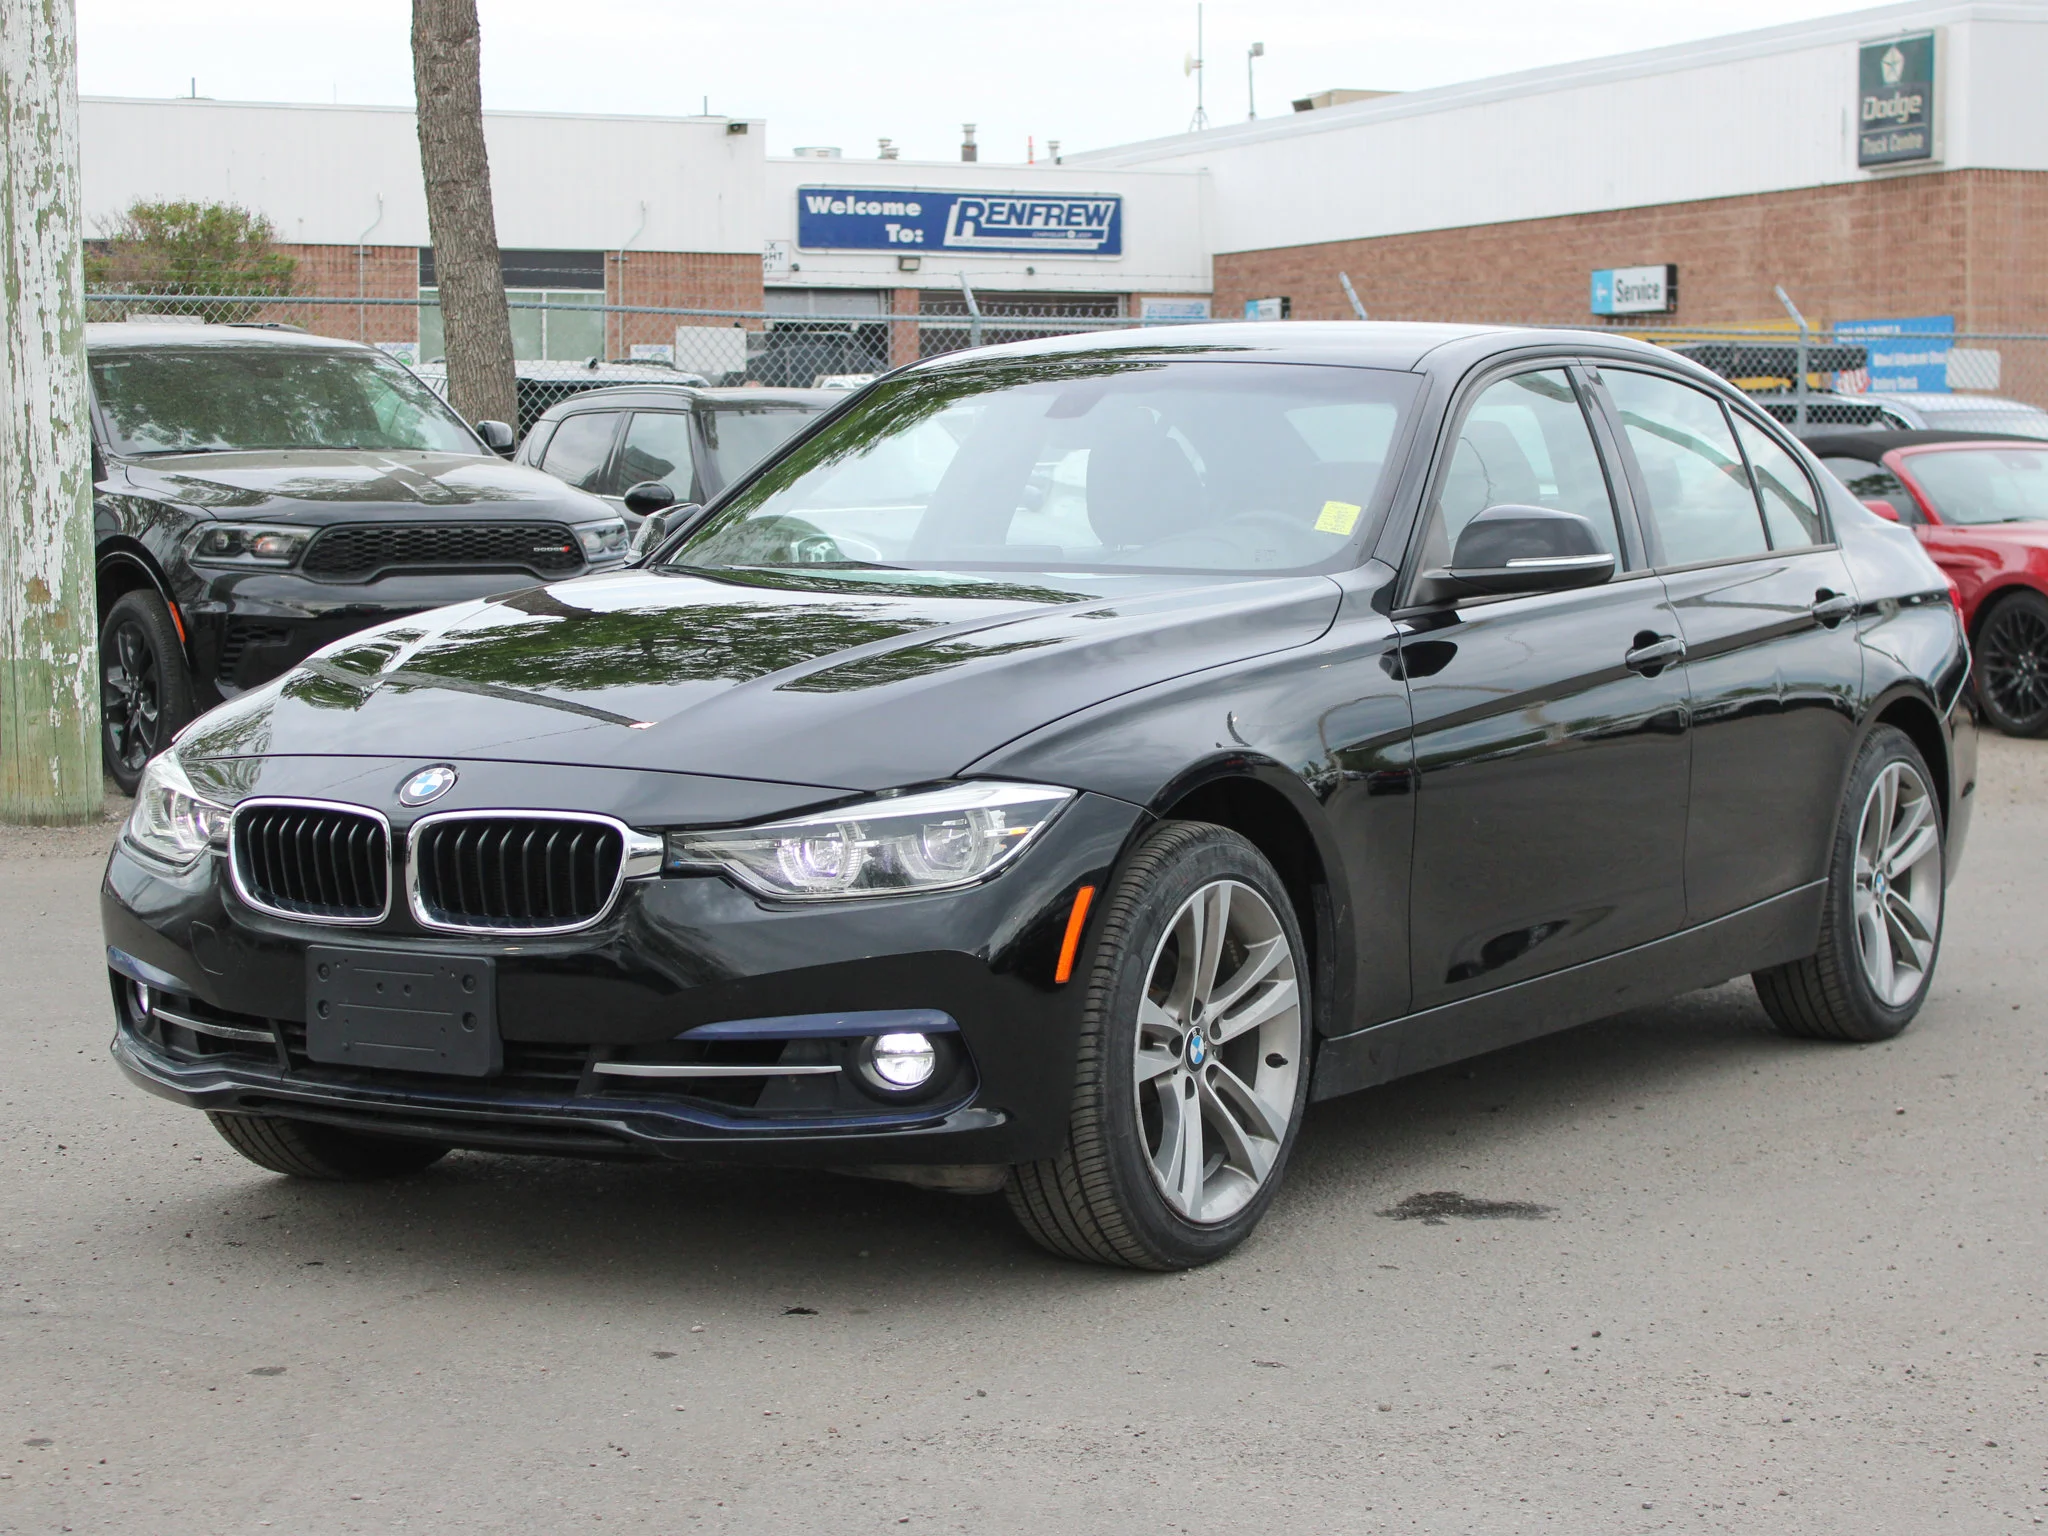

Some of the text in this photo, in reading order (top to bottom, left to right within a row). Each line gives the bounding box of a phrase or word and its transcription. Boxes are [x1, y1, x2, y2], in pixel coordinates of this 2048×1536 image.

[1863, 91, 1923, 123] Dodge
[806, 196, 922, 217] Welcome
[953, 198, 1114, 238] RENFREW
[885, 223, 924, 243] To:
[1616, 275, 1660, 303] Service
